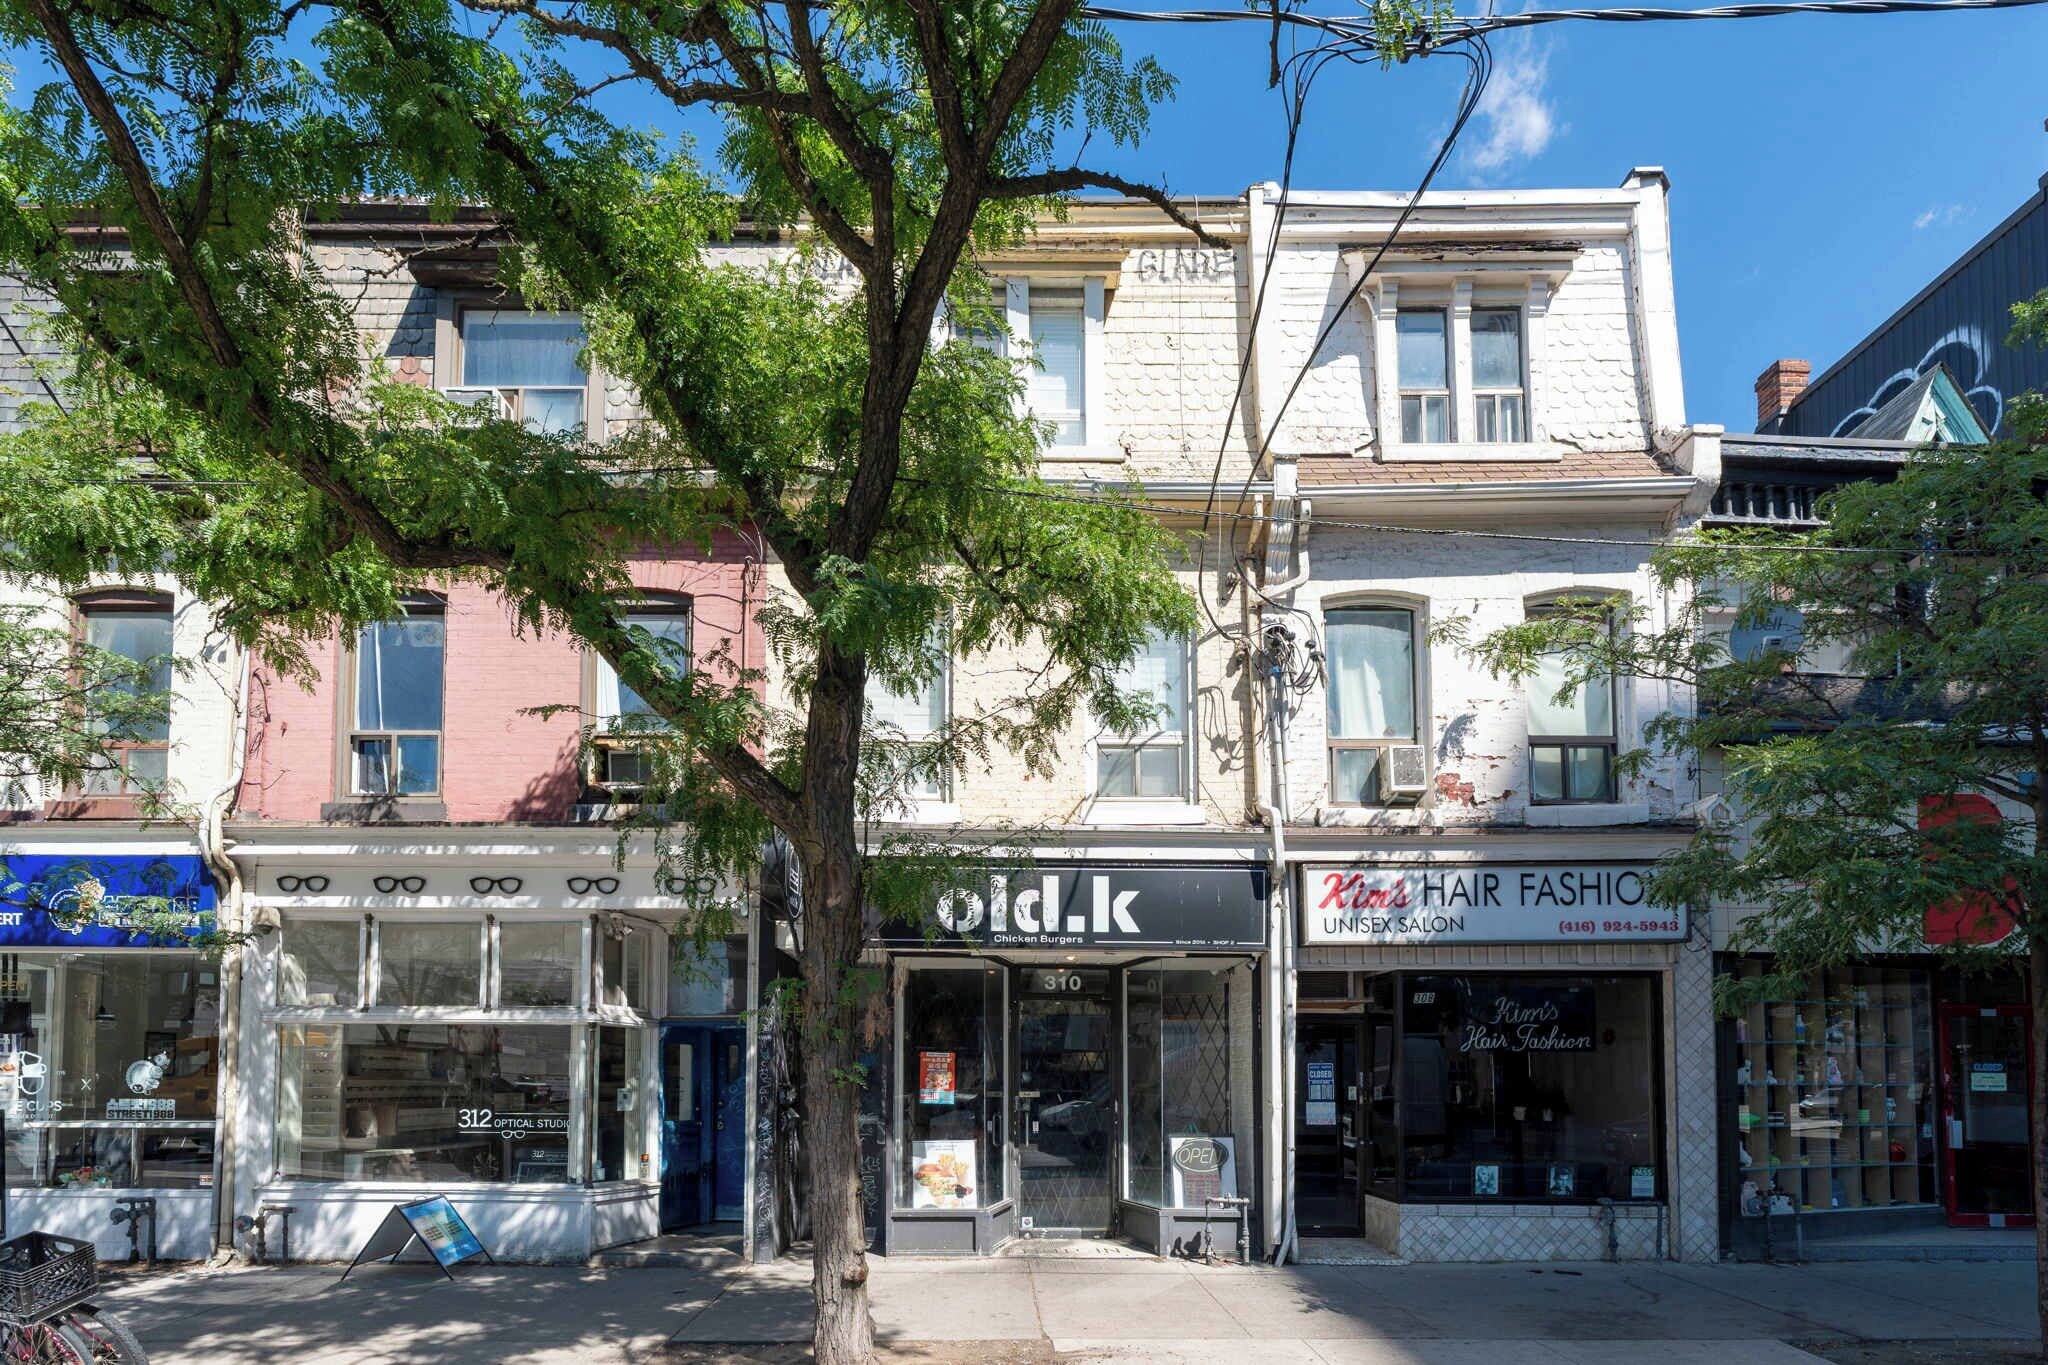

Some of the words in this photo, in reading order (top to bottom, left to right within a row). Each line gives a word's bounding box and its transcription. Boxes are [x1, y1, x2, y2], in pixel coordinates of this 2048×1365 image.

[1318, 873, 1412, 910] Kim's
[1423, 873, 1501, 907] HAIR
[1520, 871, 1660, 907] FASHIO
[936, 875, 1141, 933] old.k
[1323, 917, 1392, 935] UNISEX
[1398, 915, 1465, 933] SALON
[1558, 919, 1597, 936] (416)
[1603, 918, 1680, 934] 924-5943
[993, 934, 1038, 944] Chicken
[1040, 935, 1084, 945] Burgers
[1044, 975, 1081, 990] 310
[1493, 997, 1559, 1024] Kim's
[1460, 1025, 1508, 1052] Hair
[1512, 1022, 1592, 1052] Fashion
[1310, 1070, 1332, 1079] CLOSED
[458, 1109, 492, 1127] 312
[494, 1118, 534, 1128] OPTICAL
